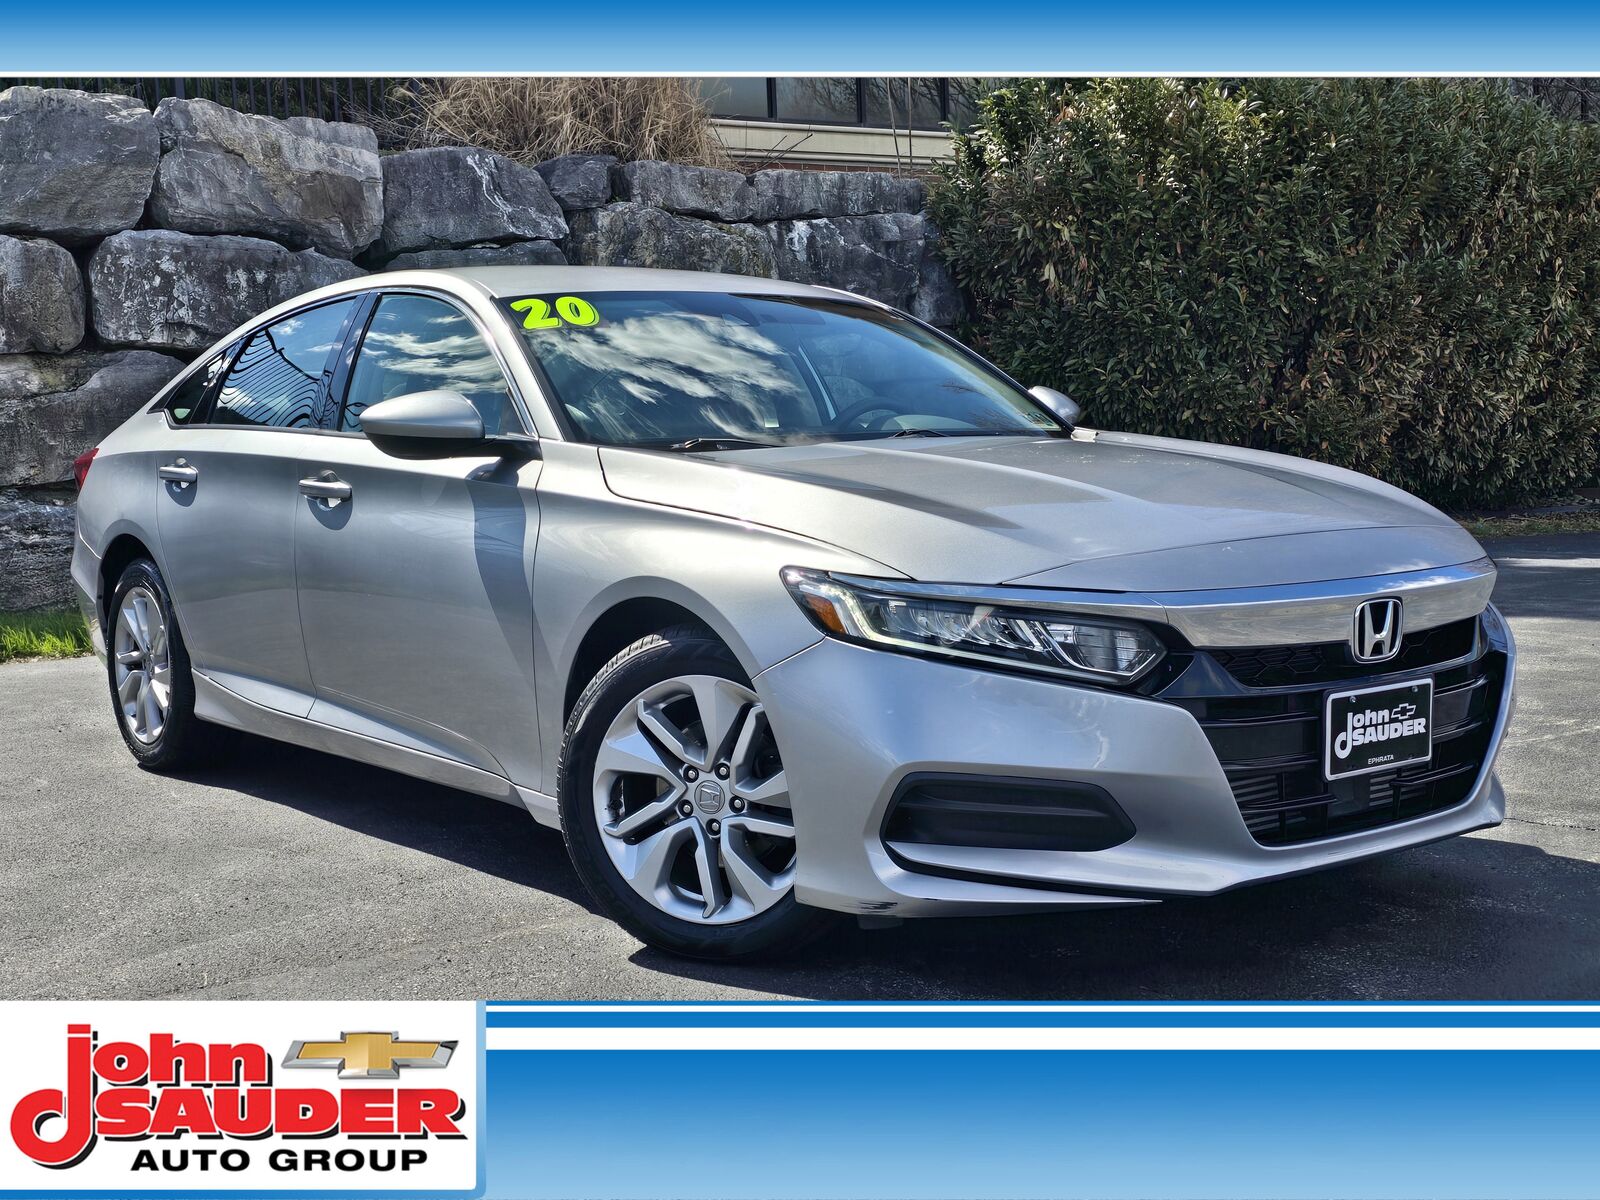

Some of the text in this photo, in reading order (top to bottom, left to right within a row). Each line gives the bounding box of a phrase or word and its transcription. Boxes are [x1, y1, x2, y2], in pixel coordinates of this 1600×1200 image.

[510, 296, 600, 329] 20
[1352, 717, 1426, 746] SAUDER
[1367, 754, 1394, 765] EPHRATA
